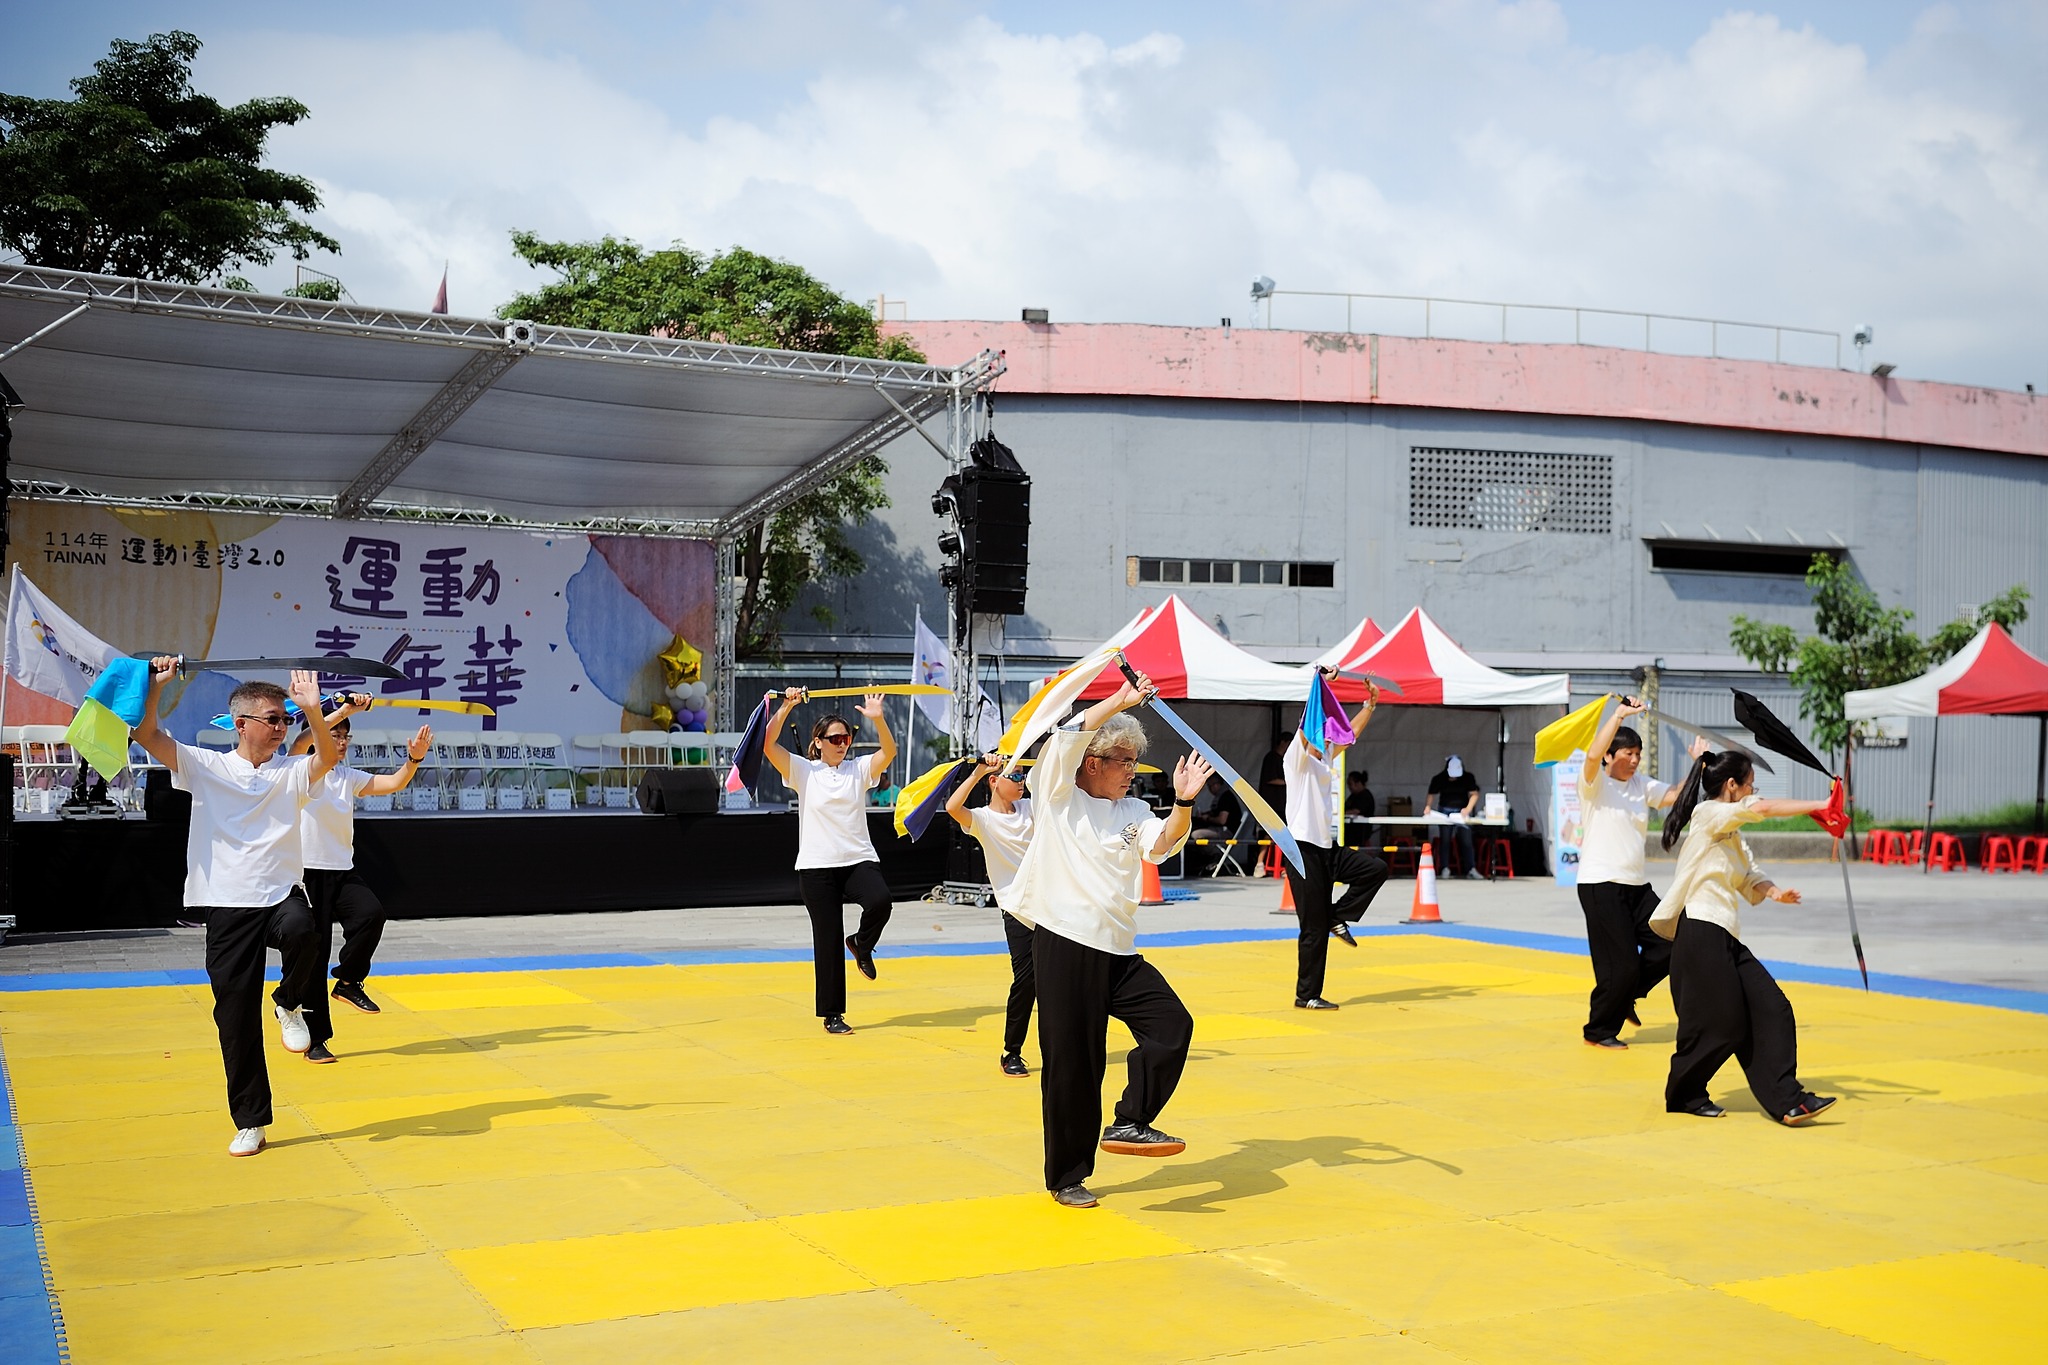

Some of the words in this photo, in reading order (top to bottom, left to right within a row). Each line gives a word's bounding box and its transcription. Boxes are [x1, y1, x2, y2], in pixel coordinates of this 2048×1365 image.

[45, 531, 108, 549] 114年
[43, 550, 107, 565] TAINAN
[325, 537, 501, 619] 運動
